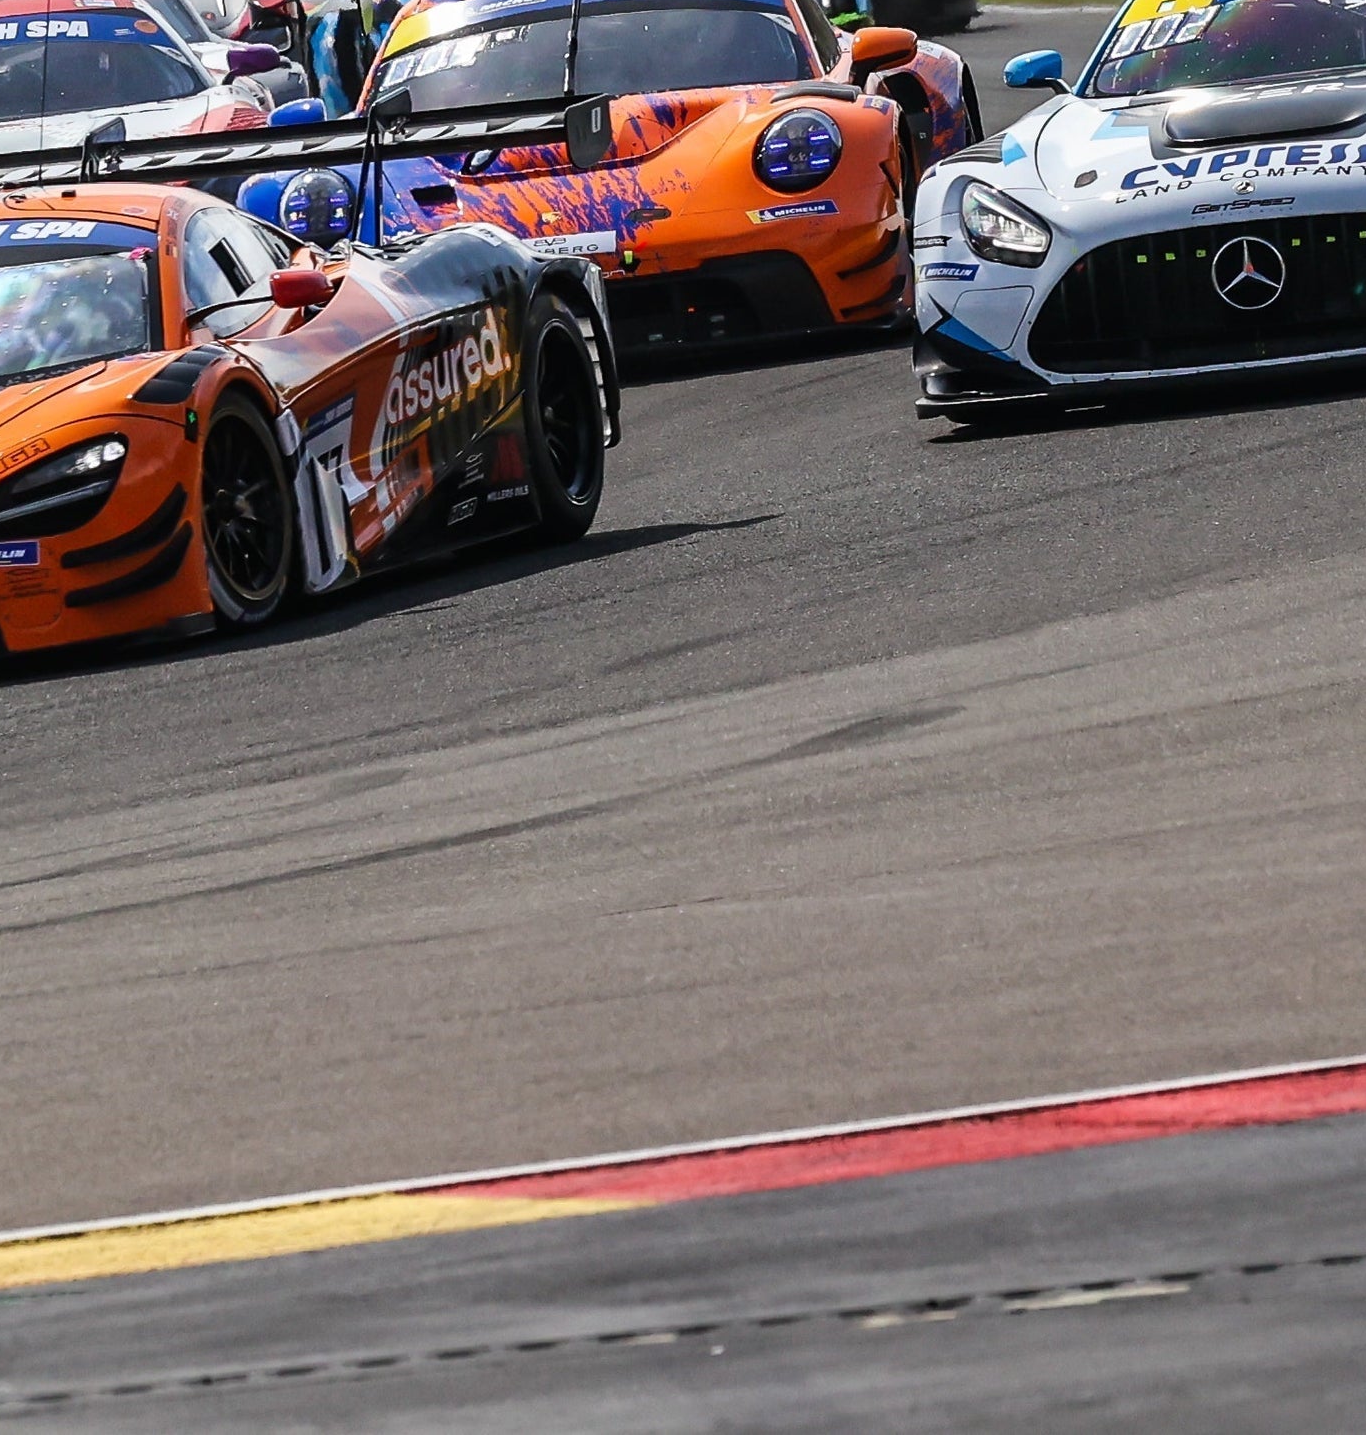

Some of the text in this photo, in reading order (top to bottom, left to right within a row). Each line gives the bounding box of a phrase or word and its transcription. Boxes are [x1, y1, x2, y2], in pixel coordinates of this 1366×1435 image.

[24, 19, 90, 39] SPA
[1115, 179, 1194, 205] LAND
[775, 204, 827, 217] MICHELIN
[9, 220, 98, 241] SPA
[925, 266, 974, 278] MICHELIN
[385, 307, 512, 426] assured.
